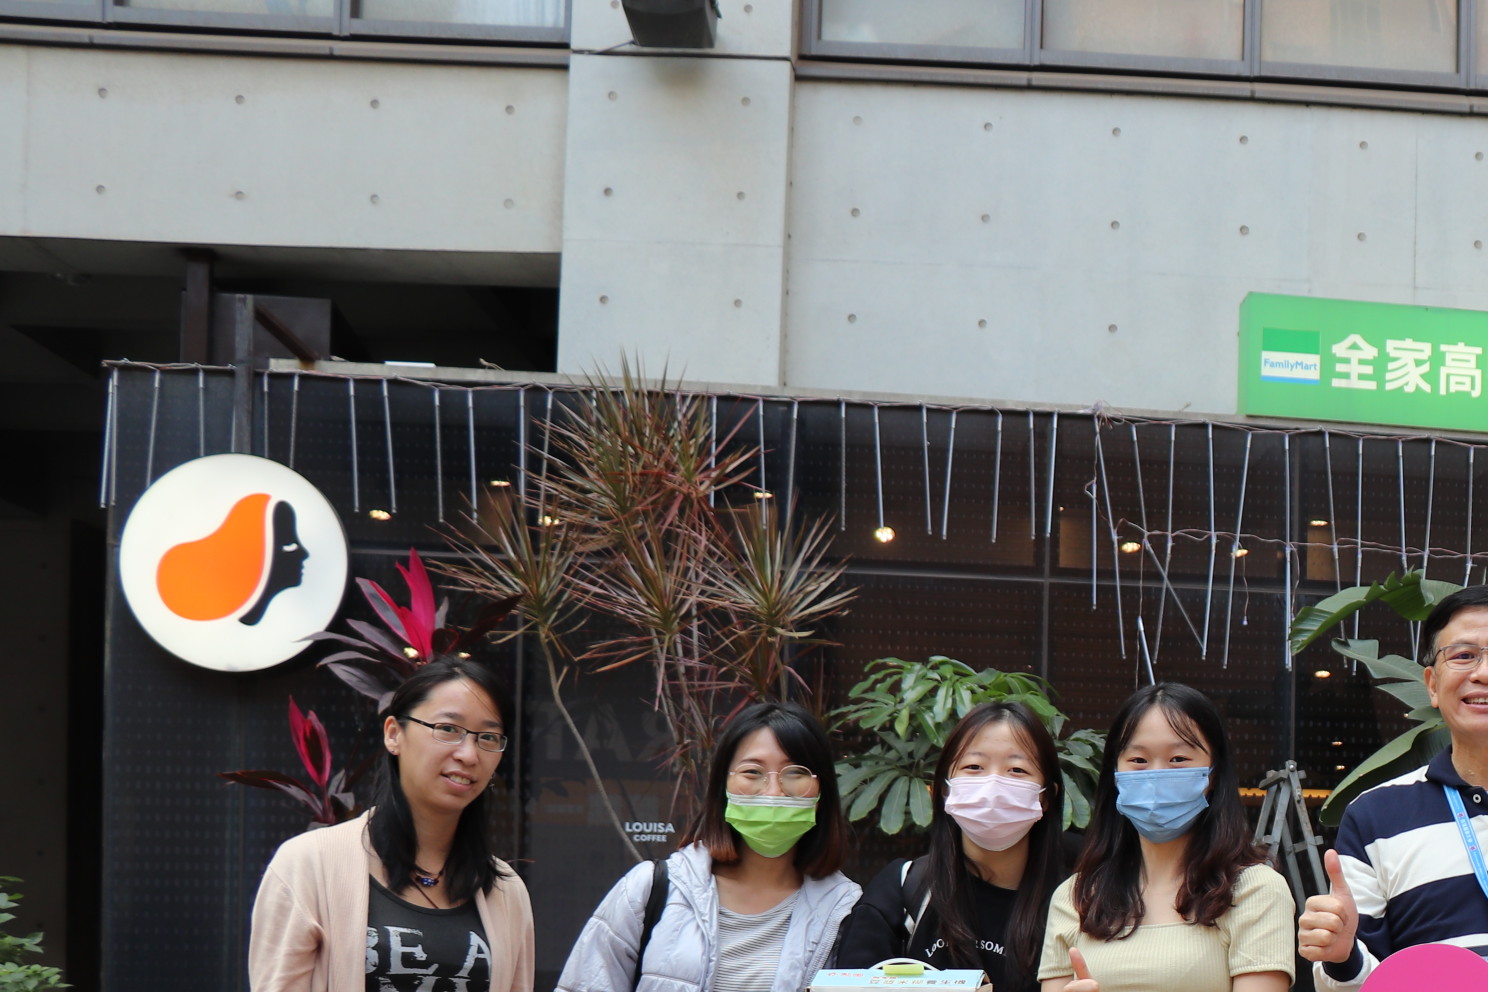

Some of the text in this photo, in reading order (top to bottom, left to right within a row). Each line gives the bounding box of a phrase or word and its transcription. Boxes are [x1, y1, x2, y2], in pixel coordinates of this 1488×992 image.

[1264, 357, 1317, 371] FamilyMart
[624, 821, 675, 833] LOUISA
[633, 834, 667, 842] COFFEE
